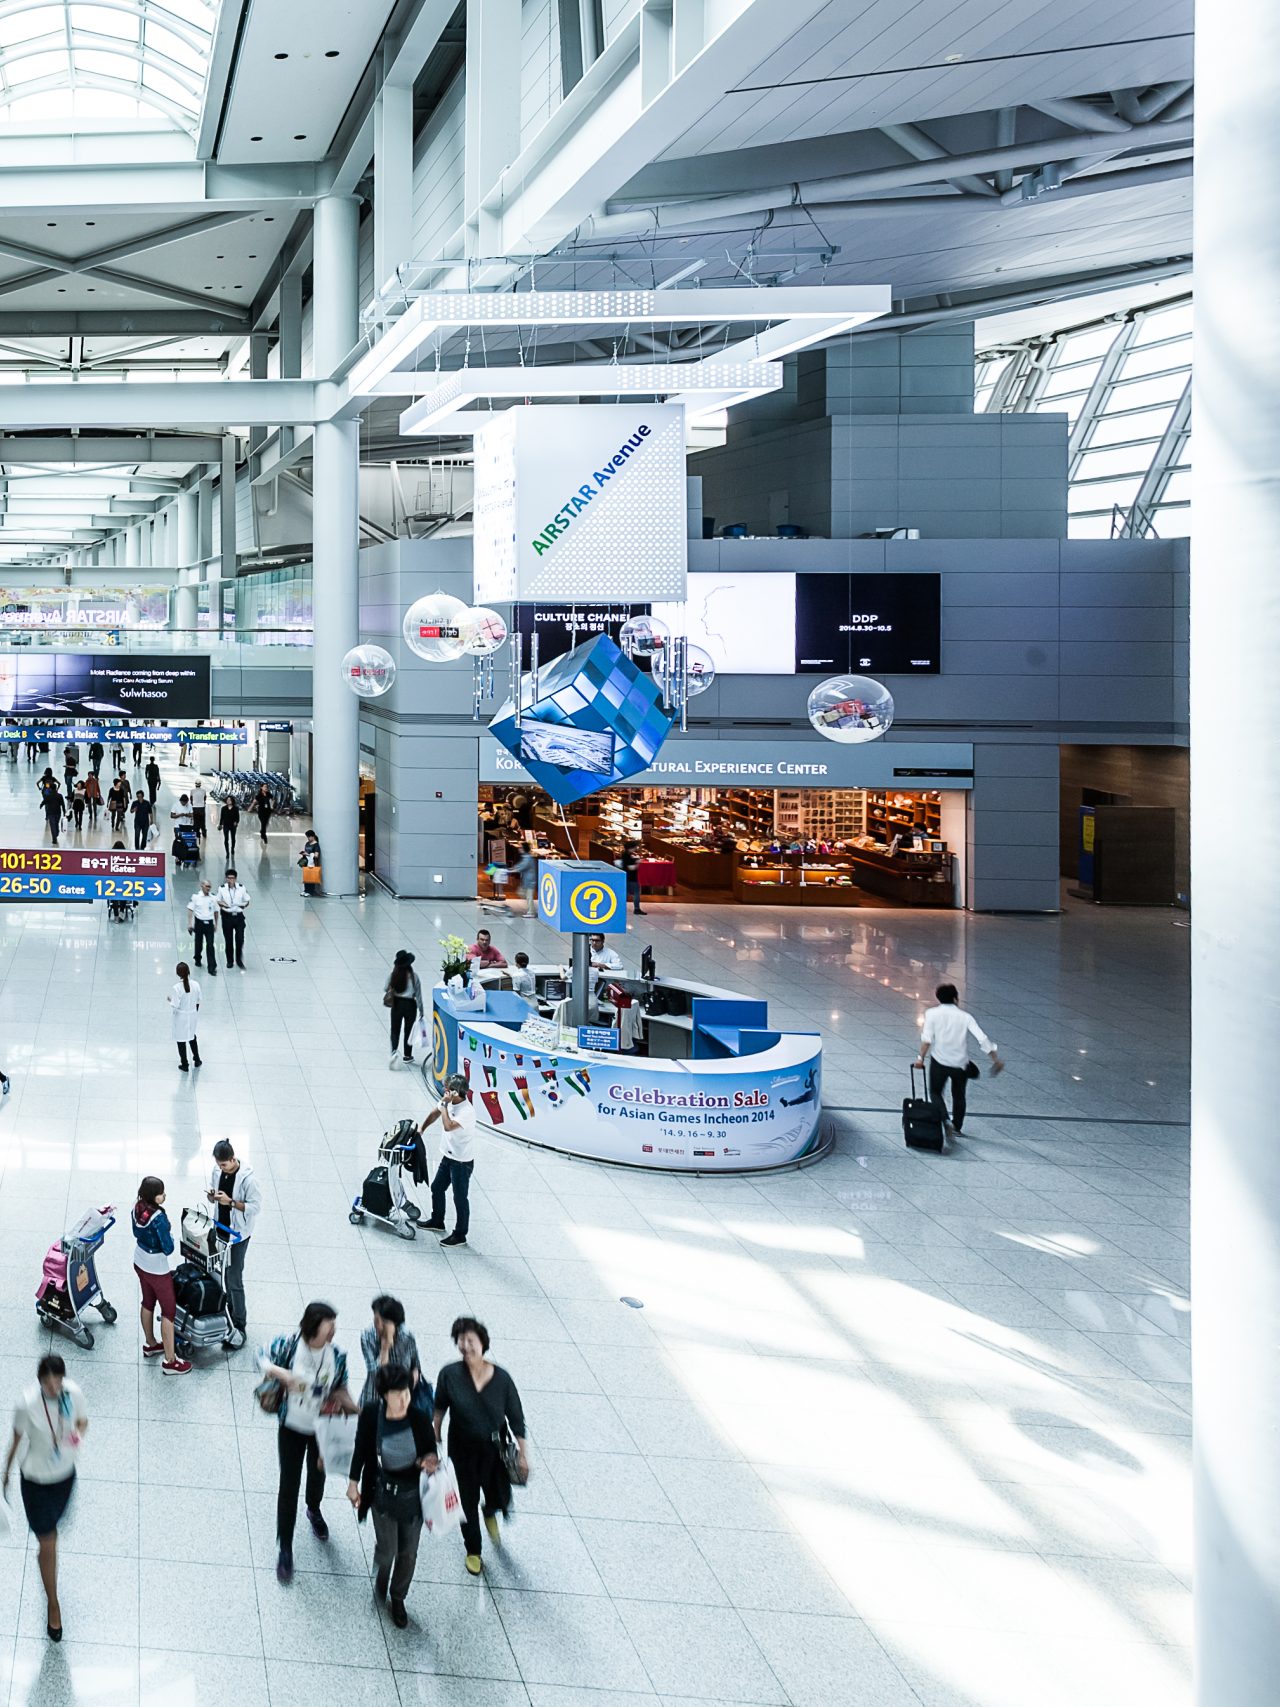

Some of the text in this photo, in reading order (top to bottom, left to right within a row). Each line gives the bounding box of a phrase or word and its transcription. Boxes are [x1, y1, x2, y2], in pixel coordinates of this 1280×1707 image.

[532, 424, 652, 556] AIRSTAR Avenue
[534, 612, 586, 622] CULTURE
[852, 615, 878, 623] DDP
[120, 688, 168, 698] Sulwhasoo
[3, 730, 20, 739] Desk
[21, 730, 27, 739] B
[46, 730, 98, 739] Rest & Relax
[116, 730, 172, 740] KAL First Lounge
[188, 731, 245, 740] Transfer Desk C
[496, 757, 526, 770] KOR
[646, 761, 692, 773] LTURAL
[0, 852, 62, 871] 101-132
[113, 865, 136, 873] Gates
[0, 877, 85, 895] 26-50 Gates
[95, 879, 145, 897] 12-25
[609, 1085, 768, 1108] Celebration Sale
[598, 1102, 775, 1124] for Asian Games Incheon 2014
[687, 1130, 698, 1138] 16
[716, 1130, 726, 1138] 30
